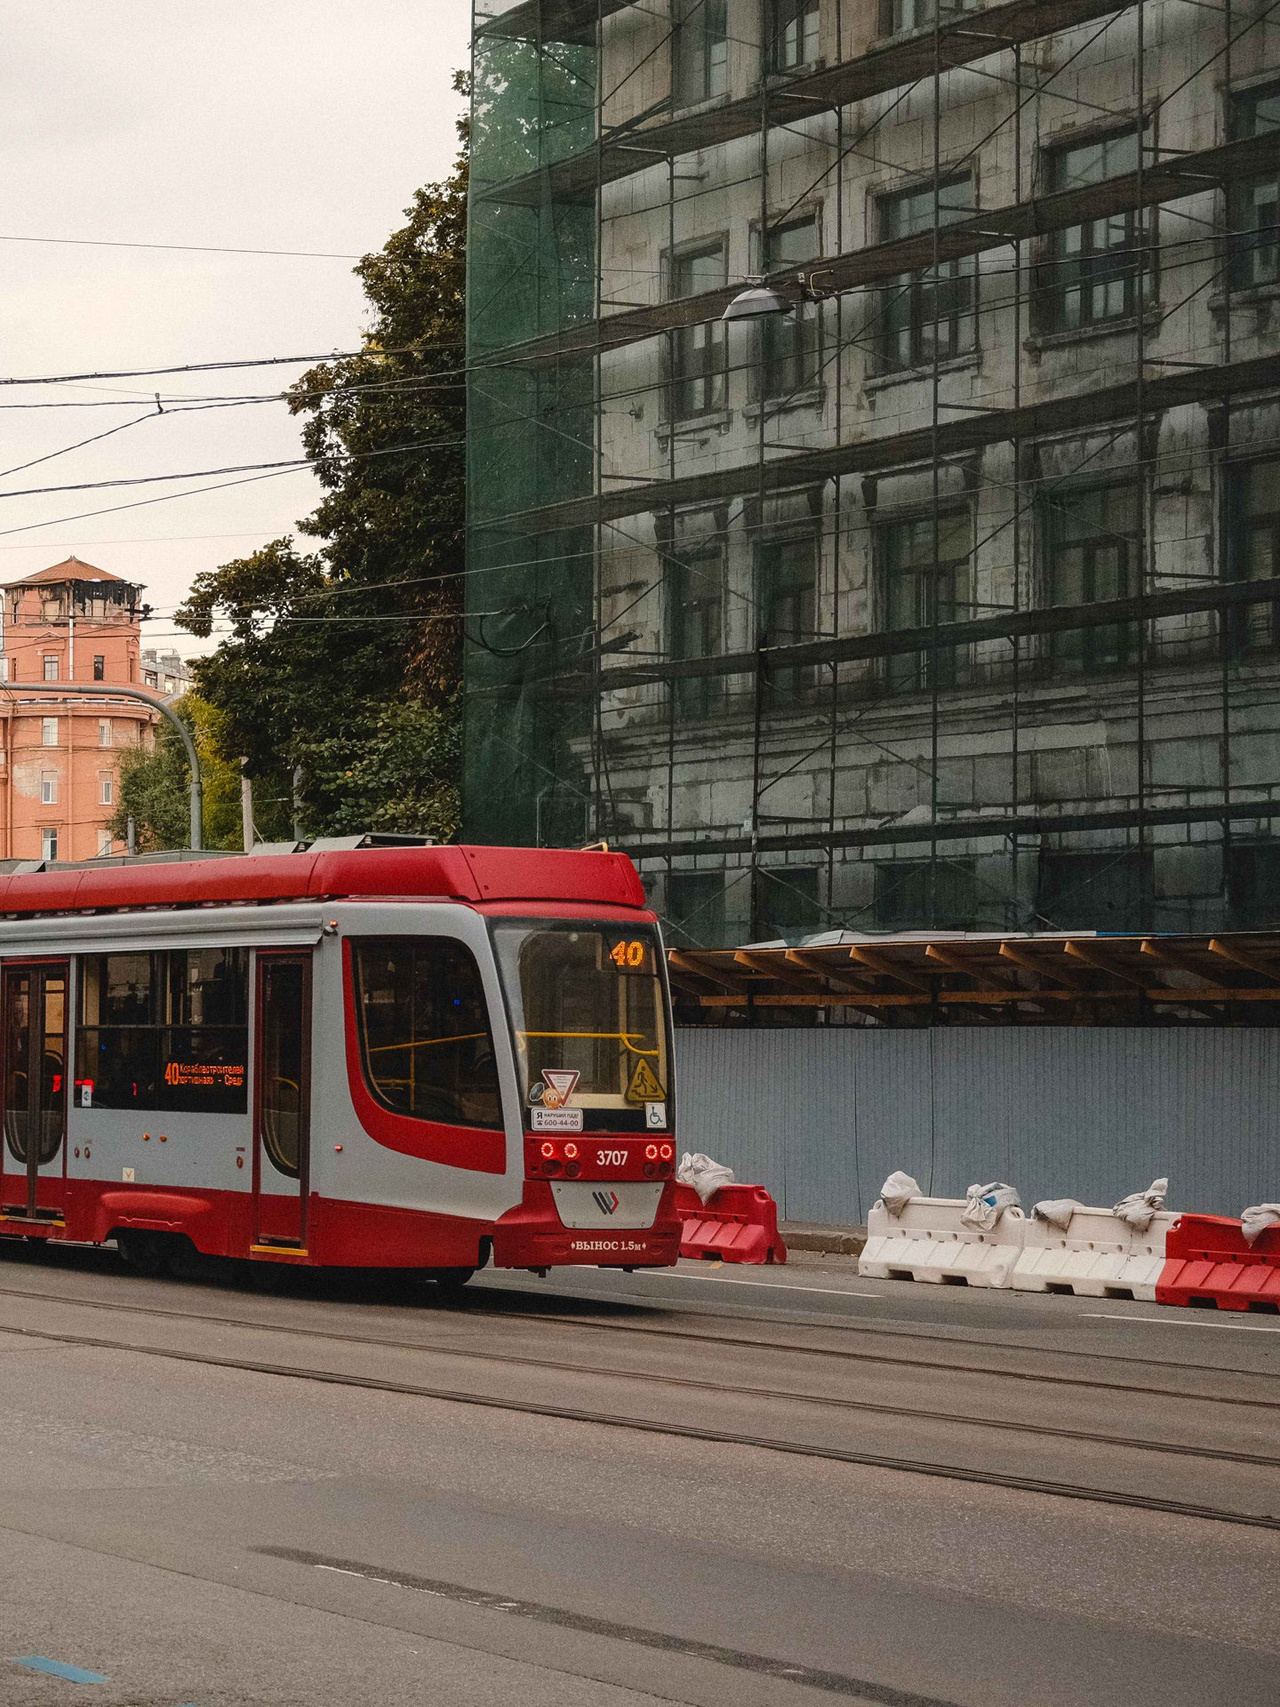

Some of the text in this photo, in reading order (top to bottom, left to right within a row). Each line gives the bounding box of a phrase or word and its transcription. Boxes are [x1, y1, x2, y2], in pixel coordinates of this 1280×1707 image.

[609, 940, 644, 966] 40
[164, 1062, 179, 1086] 40
[536, 1111, 543, 1119] Я
[544, 1119, 579, 1127] 600-44-00
[596, 1150, 628, 1165] 3707
[575, 1241, 619, 1251] ВЫНОС
